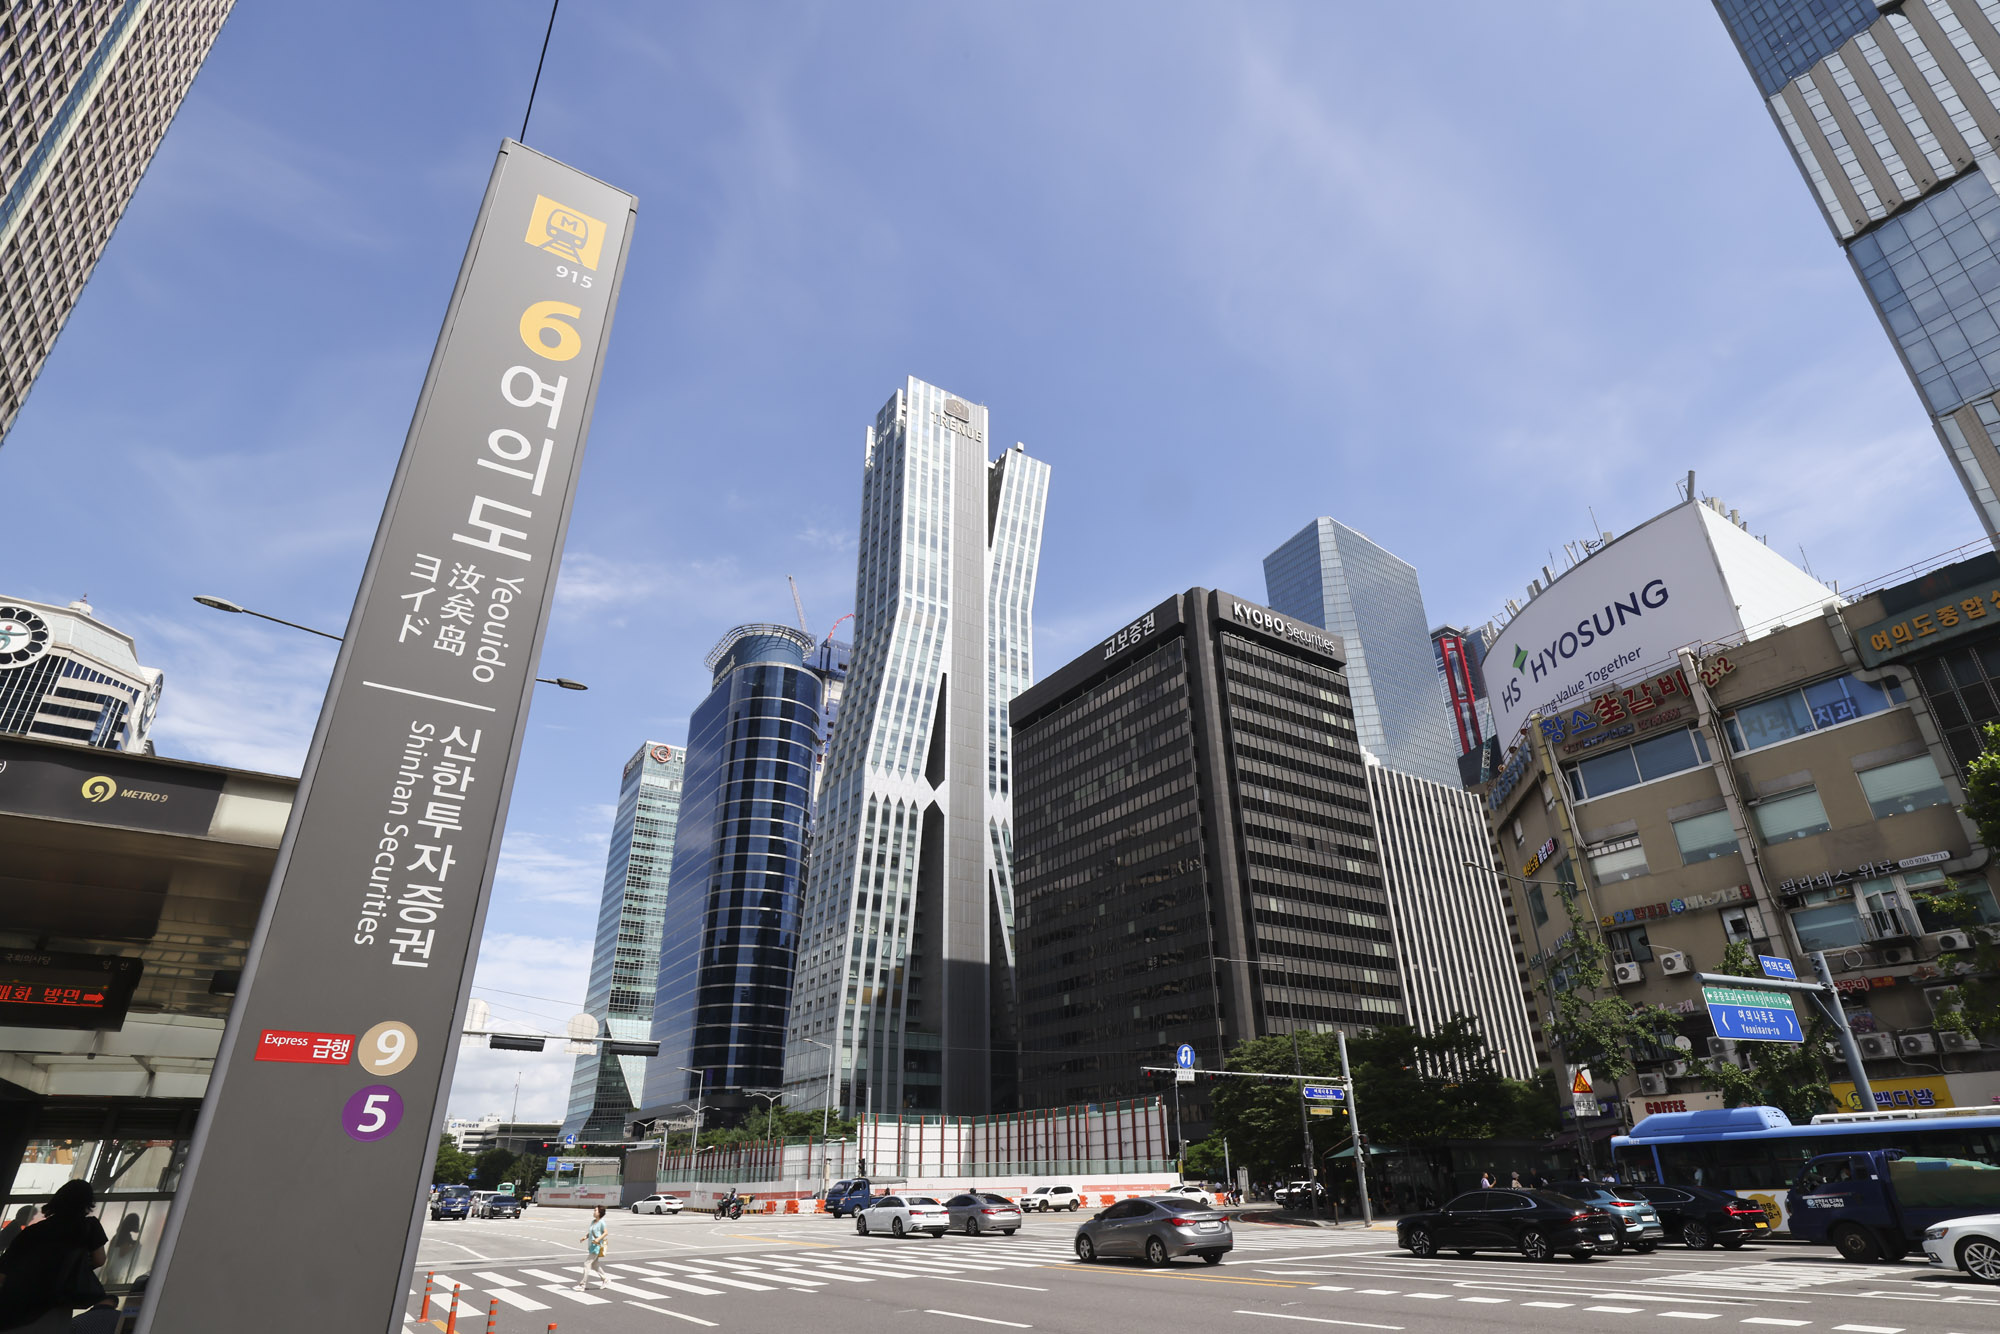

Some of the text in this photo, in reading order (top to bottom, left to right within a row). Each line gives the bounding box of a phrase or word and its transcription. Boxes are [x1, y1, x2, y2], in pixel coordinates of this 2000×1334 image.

[555, 265, 593, 289] 915
[519, 300, 582, 361] 6
[931, 411, 982, 443] TRENUE
[452, 365, 568, 561] 여의도
[398, 553, 442, 643] ヨイド
[433, 562, 485, 657] 汝矣岛
[472, 576, 525, 683] Yeouido
[1104, 612, 1155, 660] 교보증권
[1233, 601, 1335, 652] KYOBO Securities
[1502, 579, 1669, 713] HS HYOSUNG
[1556, 680, 1585, 704] Value
[1585, 647, 1641, 685] Together
[1700, 655, 1737, 688] 2+2
[1814, 701, 1856, 725] 치과
[121, 789, 160, 802] METRO
[160, 794, 168, 803] 9
[354, 720, 436, 945] Shinhan Securities
[389, 725, 482, 968] 신한투자증권
[1781, 860, 1898, 896] 필라테스 위로
[1902, 852, 1947, 867] 010 9761 7711
[1763, 960, 1793, 975] 여의도역
[43, 988, 80, 1004] 방면
[1737, 1010, 1776, 1023] 여의나루로
[264, 1033, 350, 1060] Express 급행
[375, 1029, 406, 1066] 9
[356, 1094, 390, 1133] 5
[1645, 1100, 1688, 1114] COFFEE
